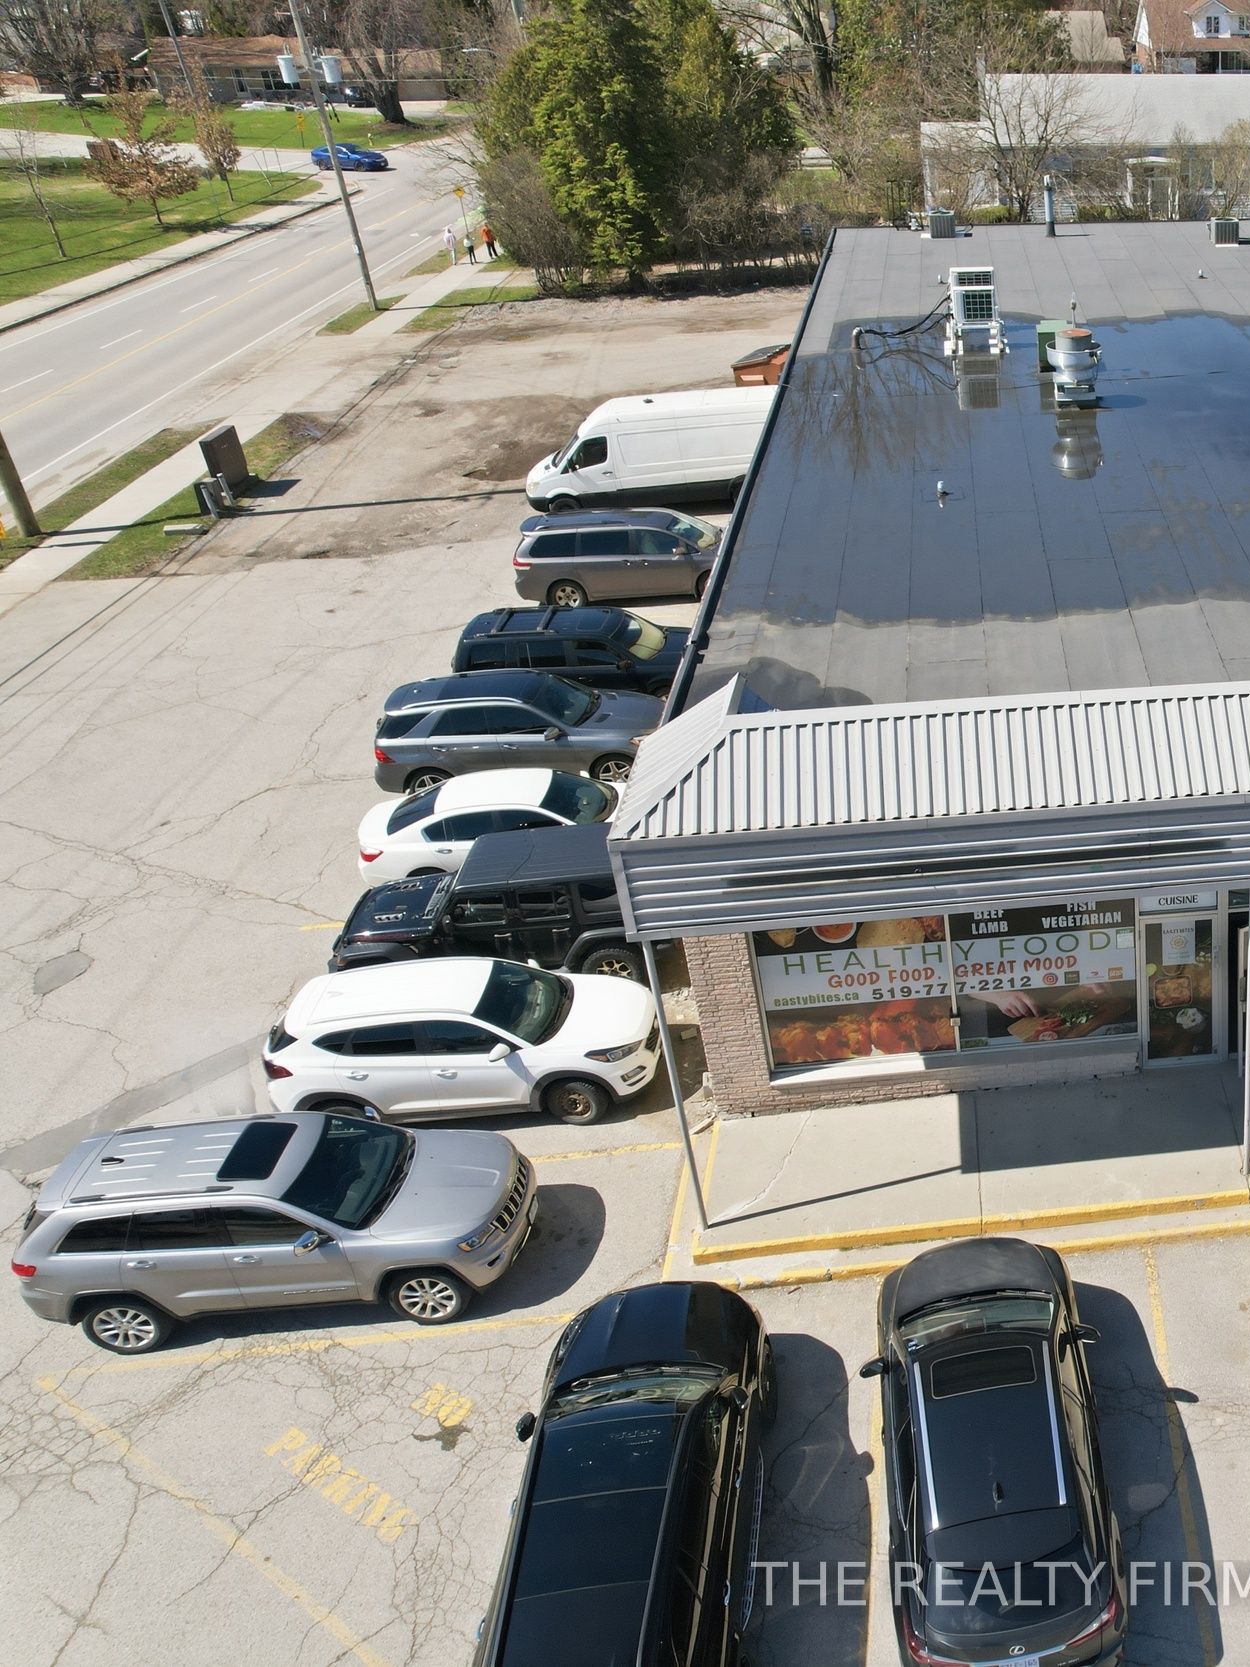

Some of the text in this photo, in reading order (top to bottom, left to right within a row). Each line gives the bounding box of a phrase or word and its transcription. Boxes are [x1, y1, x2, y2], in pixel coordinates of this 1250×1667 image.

[1158, 894, 1199, 906] CUISINE
[971, 920, 1009, 935] LAMB
[1042, 911, 1122, 929] VEGETARIAN
[782, 941, 975, 976] HEALTHY
[999, 931, 1111, 958] FOOD
[827, 971, 881, 989] GOOD
[955, 960, 1017, 978] GREAT
[1023, 955, 1078, 972] MOOD
[872, 976, 1032, 1001] 519-777-2212
[773, 991, 860, 1008] eastybites.ca
[263, 1426, 421, 1543] PARKING
